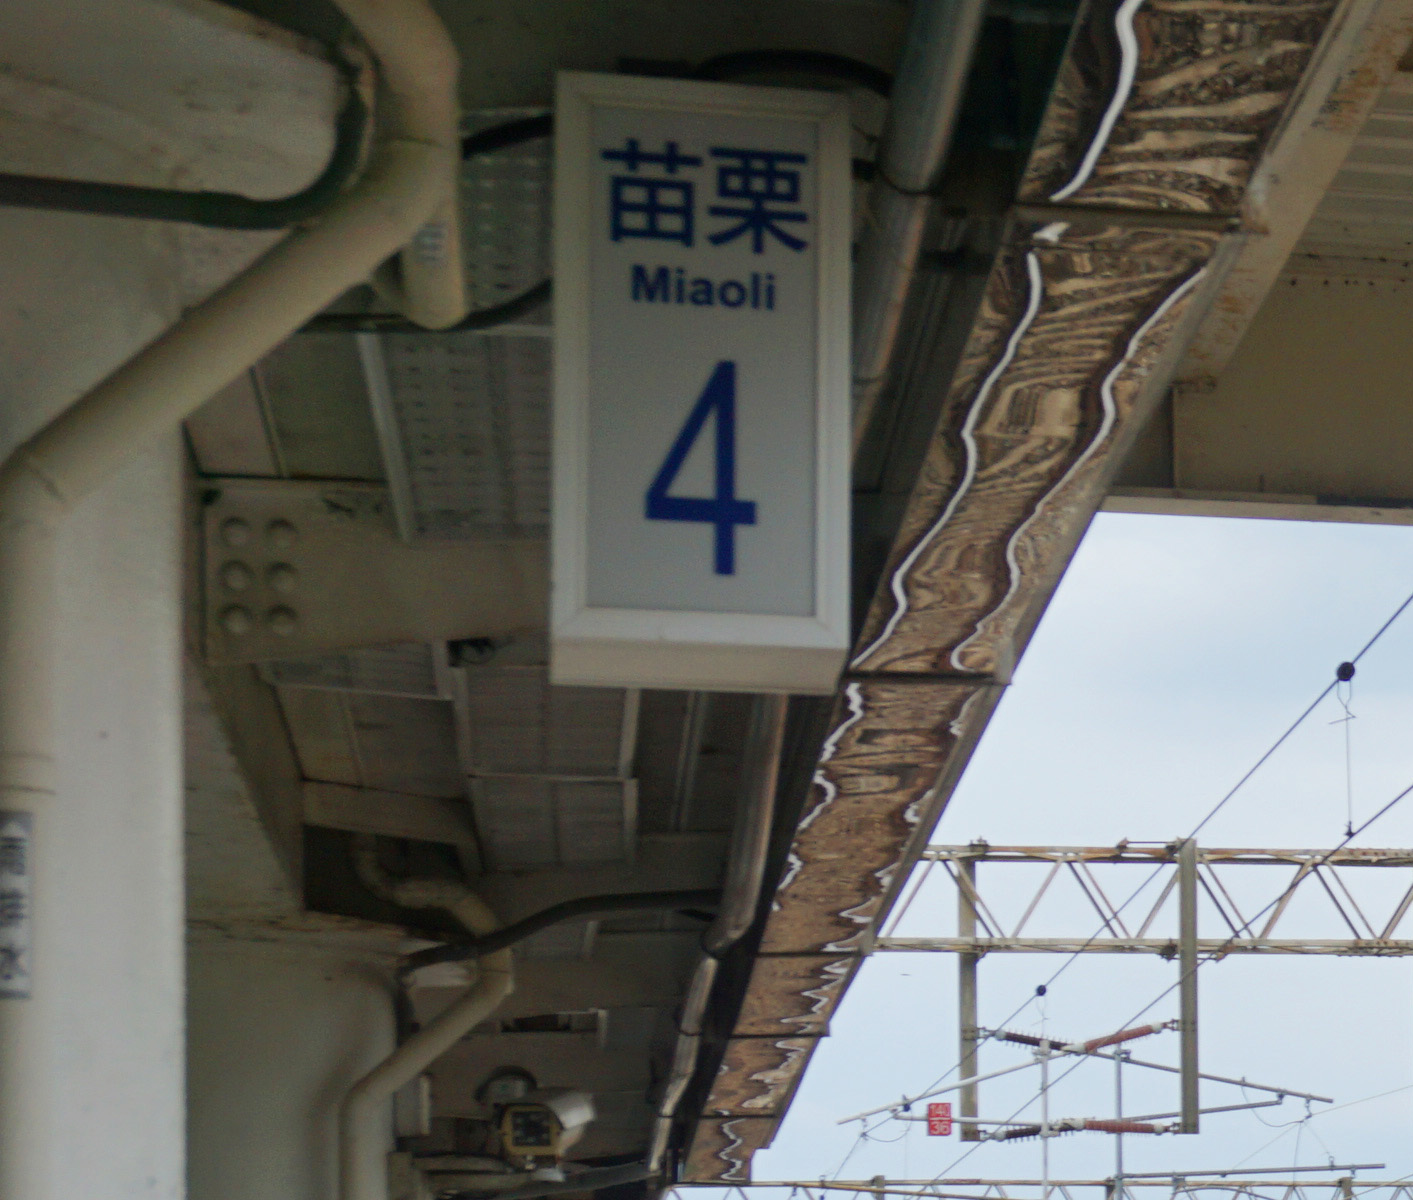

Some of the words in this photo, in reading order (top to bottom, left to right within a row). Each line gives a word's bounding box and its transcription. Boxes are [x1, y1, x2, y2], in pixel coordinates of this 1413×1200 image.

[601, 138, 809, 255] 苗栗
[631, 264, 776, 311] Miaoli
[645, 360, 757, 576] 4
